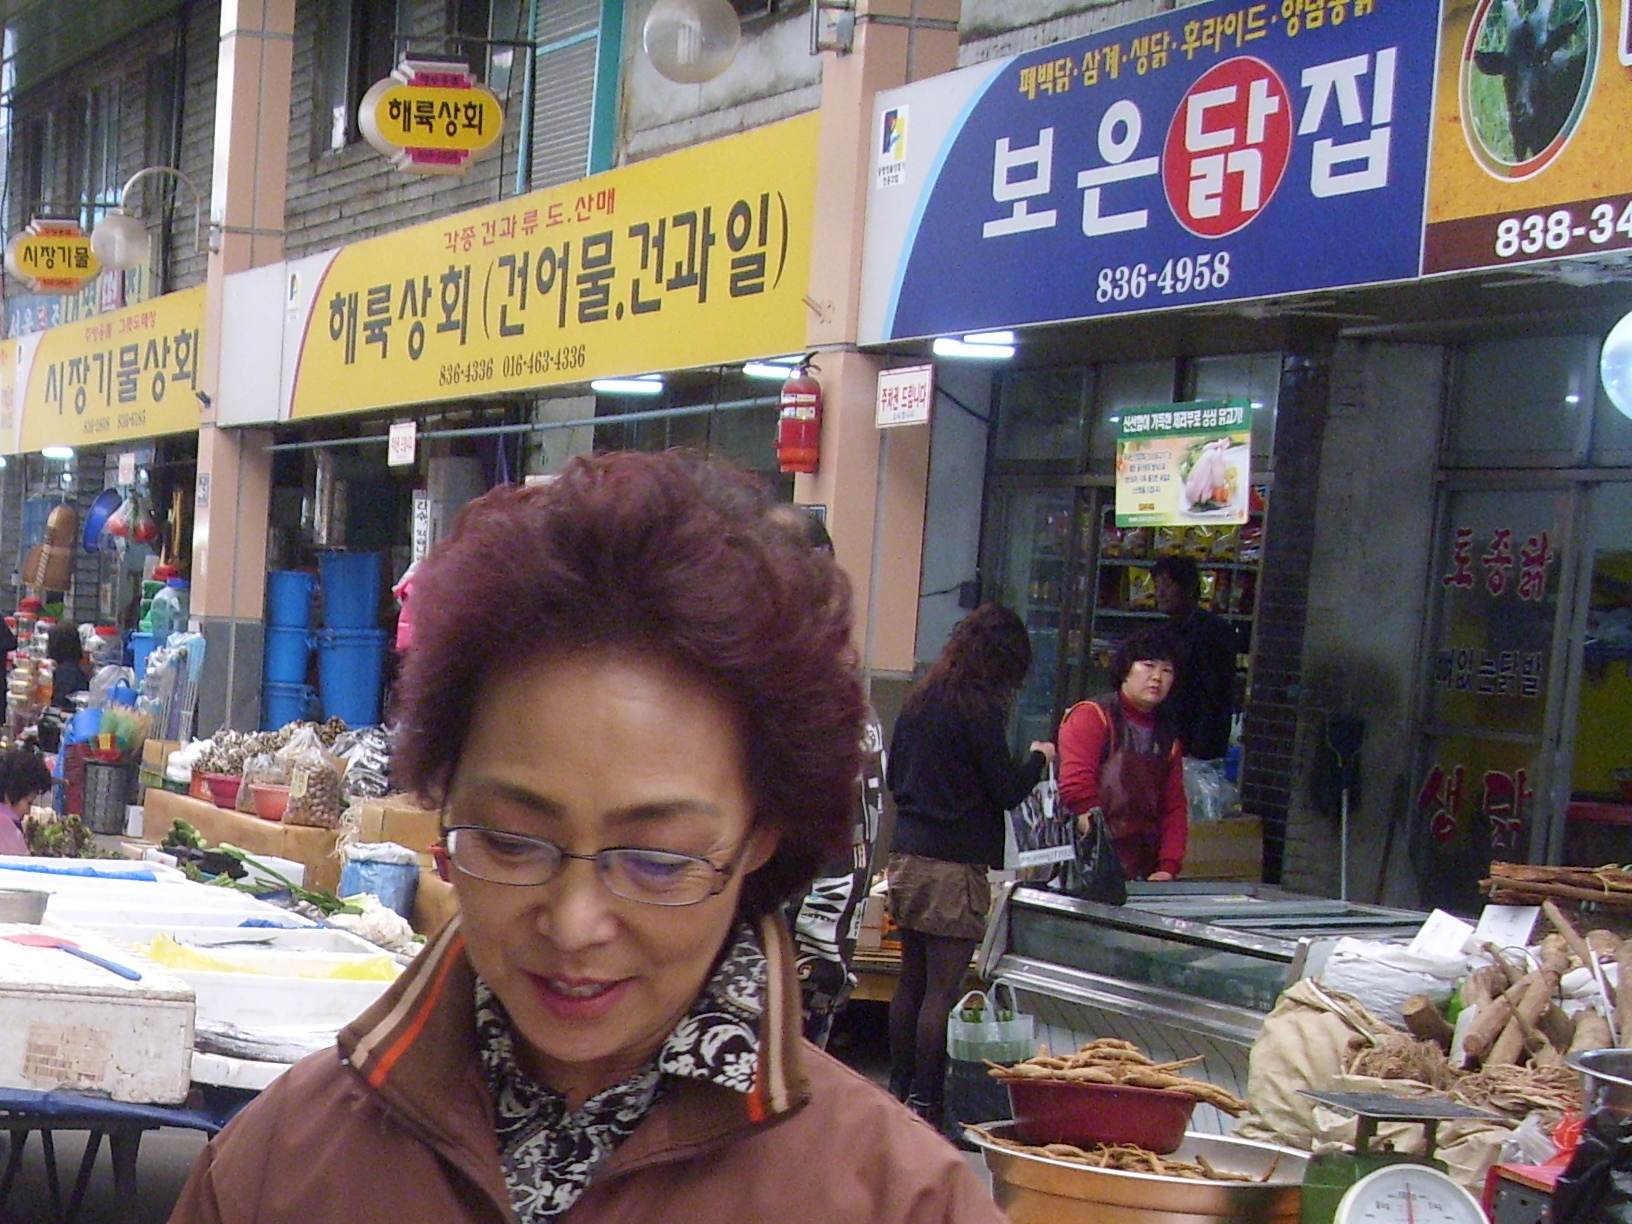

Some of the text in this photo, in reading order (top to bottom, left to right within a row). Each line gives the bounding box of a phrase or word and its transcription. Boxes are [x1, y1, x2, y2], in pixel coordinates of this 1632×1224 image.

[388, 98, 484, 137] 해륙상회
[982, 46, 1398, 239] 보은닭집
[23, 246, 90, 270] 시장기물
[444, 228, 476, 254] 각종
[1096, 252, 1231, 303] 836-4958
[45, 328, 199, 415] 시장기물상회
[1442, 528, 1553, 600] 토종닭
